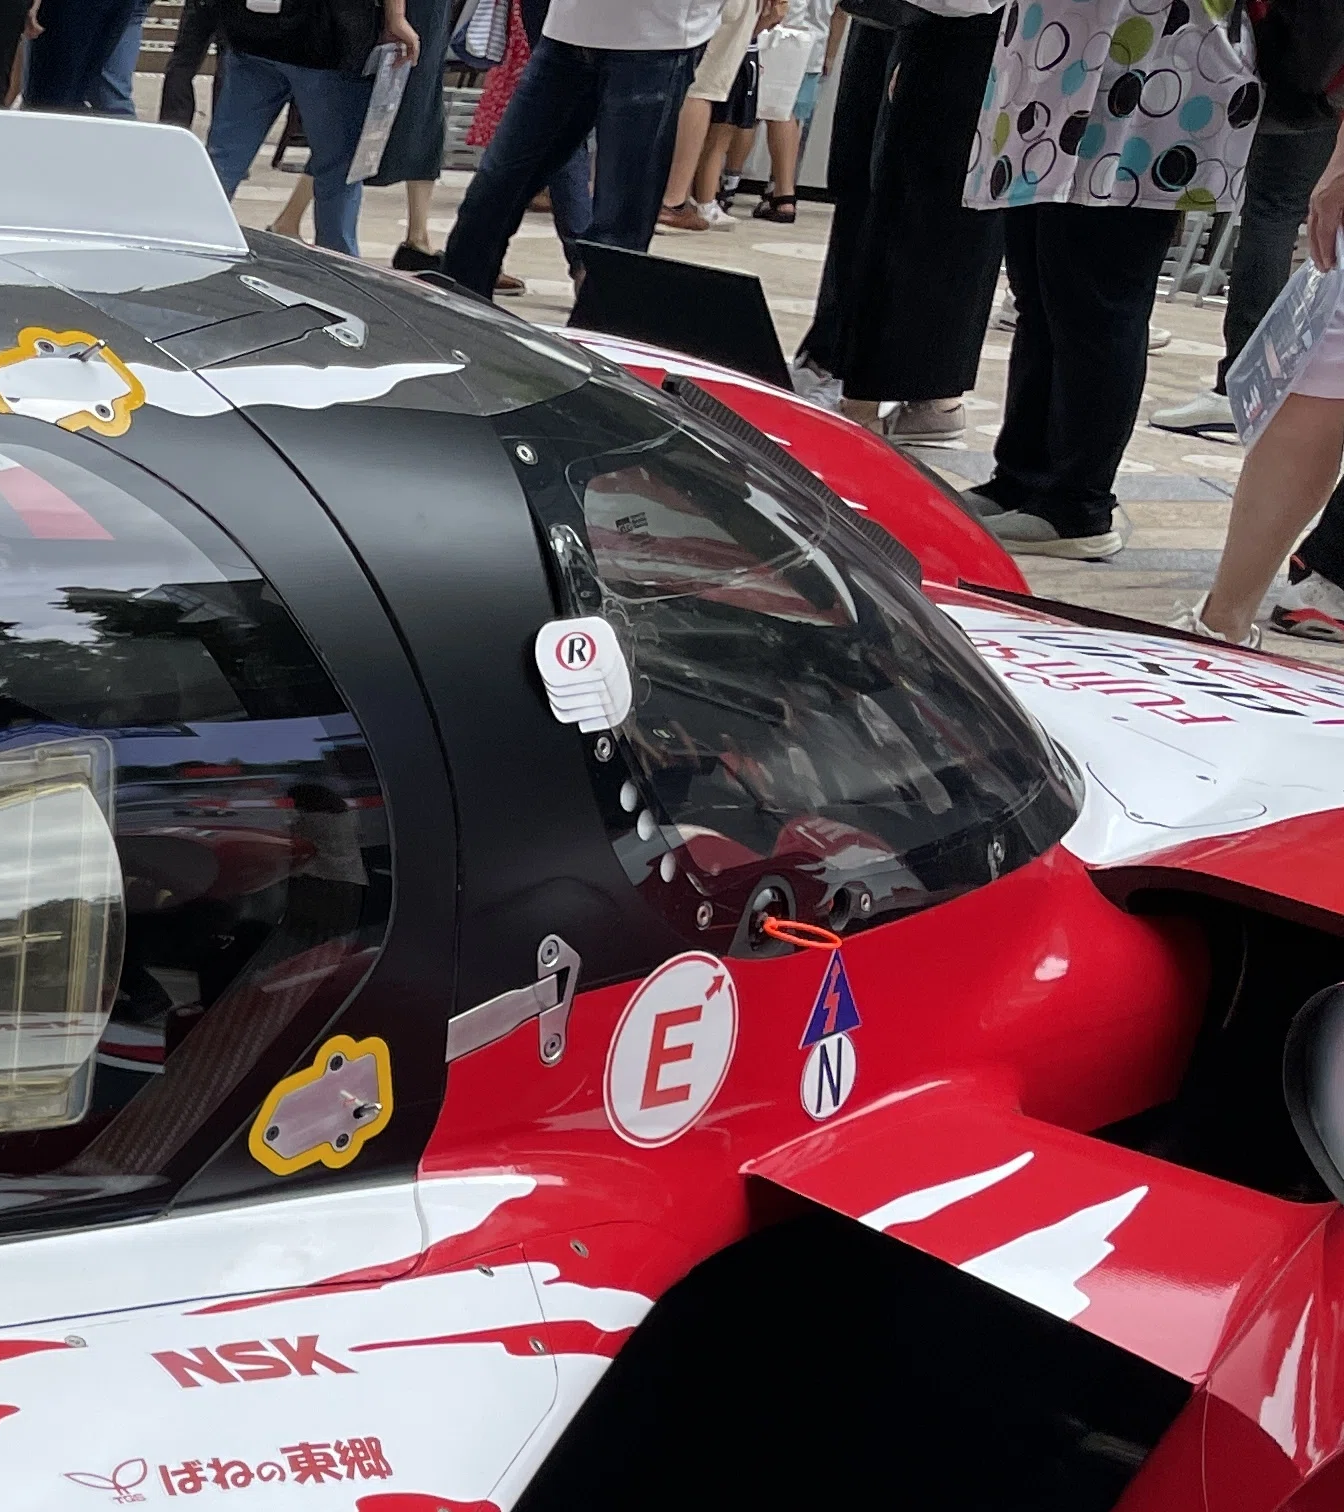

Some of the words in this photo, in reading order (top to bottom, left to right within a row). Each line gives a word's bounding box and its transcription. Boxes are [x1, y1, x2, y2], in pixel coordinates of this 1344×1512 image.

[640, 1006, 703, 1112] E
[816, 1037, 846, 1110] N
[151, 1334, 359, 1389] NSK
[158, 1436, 394, 1497] ばねの東郷
